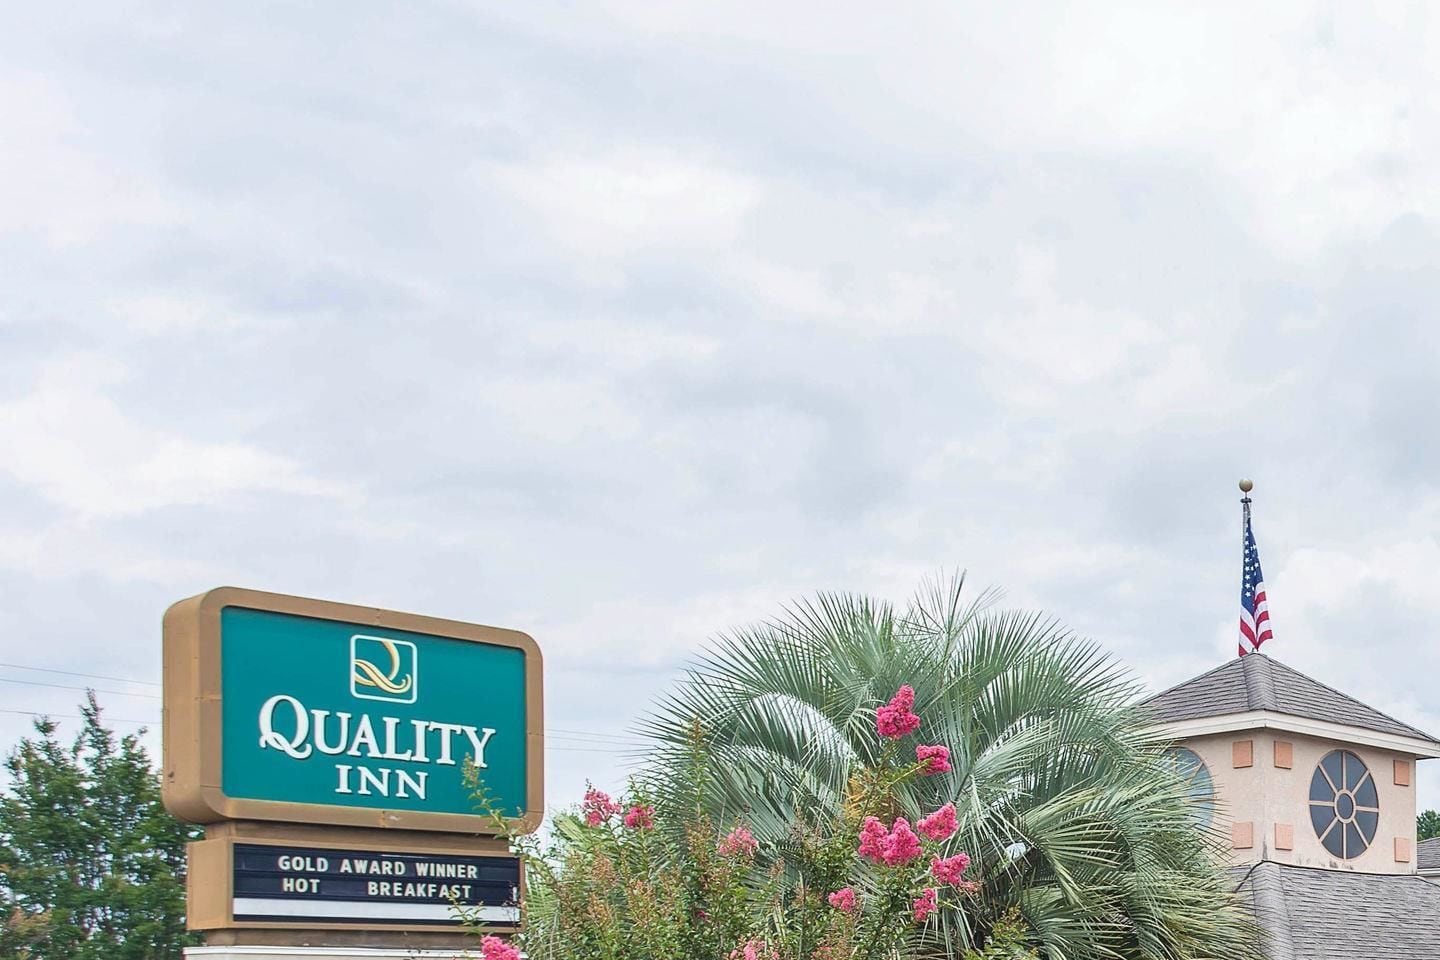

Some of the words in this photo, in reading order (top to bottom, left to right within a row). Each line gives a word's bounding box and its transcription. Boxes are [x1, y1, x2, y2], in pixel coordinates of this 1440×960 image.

[258, 694, 496, 769] QUALITY
[335, 764, 428, 800] INN
[277, 855, 329, 873] GOLD
[340, 858, 406, 876] AWARD
[415, 862, 478, 880] WINNER
[282, 877, 321, 894] HOT
[367, 881, 472, 899] BREAKFAST
